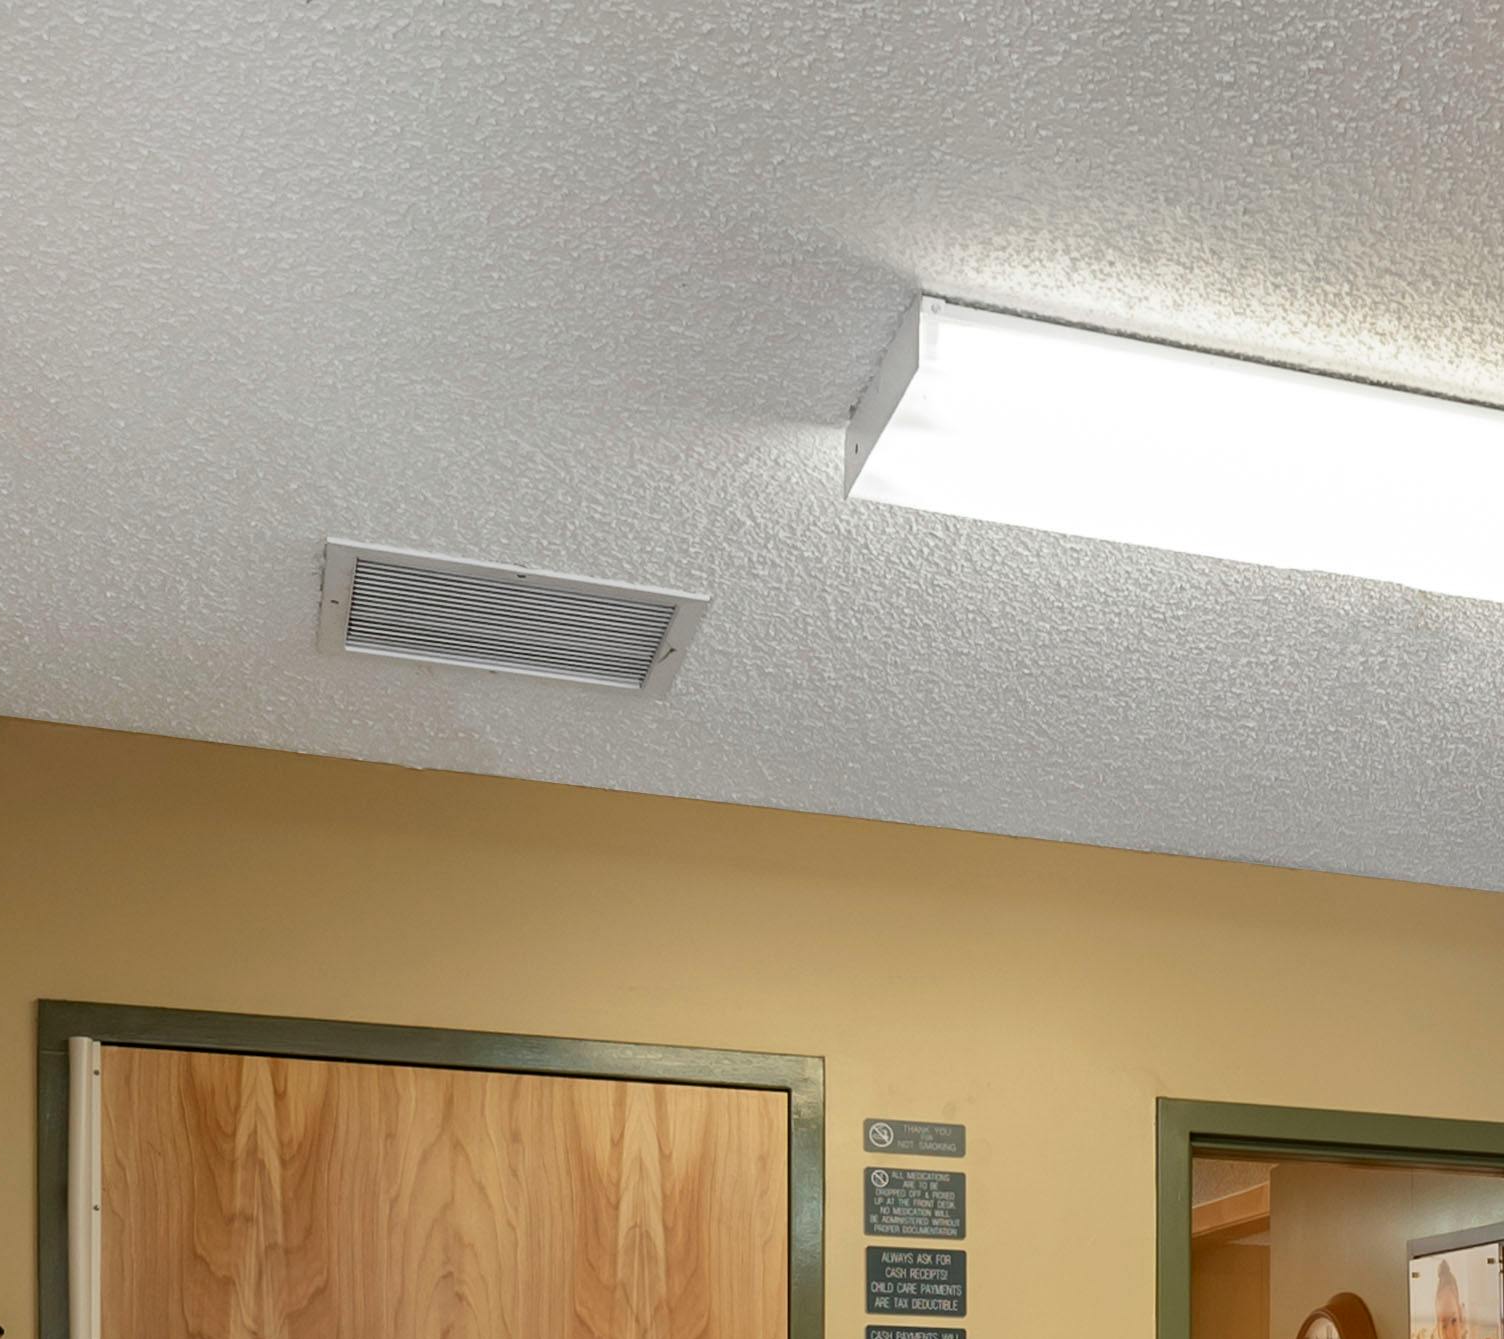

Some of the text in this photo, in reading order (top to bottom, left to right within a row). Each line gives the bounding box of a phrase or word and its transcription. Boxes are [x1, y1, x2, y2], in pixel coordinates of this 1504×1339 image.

[881, 1252, 951, 1265] ALWAYS ASK FOR
[885, 1267, 948, 1280] CASH RECEIPTS!
[871, 1281, 962, 1296] CHILD CARE PAYMENTS
[875, 1297, 958, 1311] ARE TAX DEDUCTIBLE
